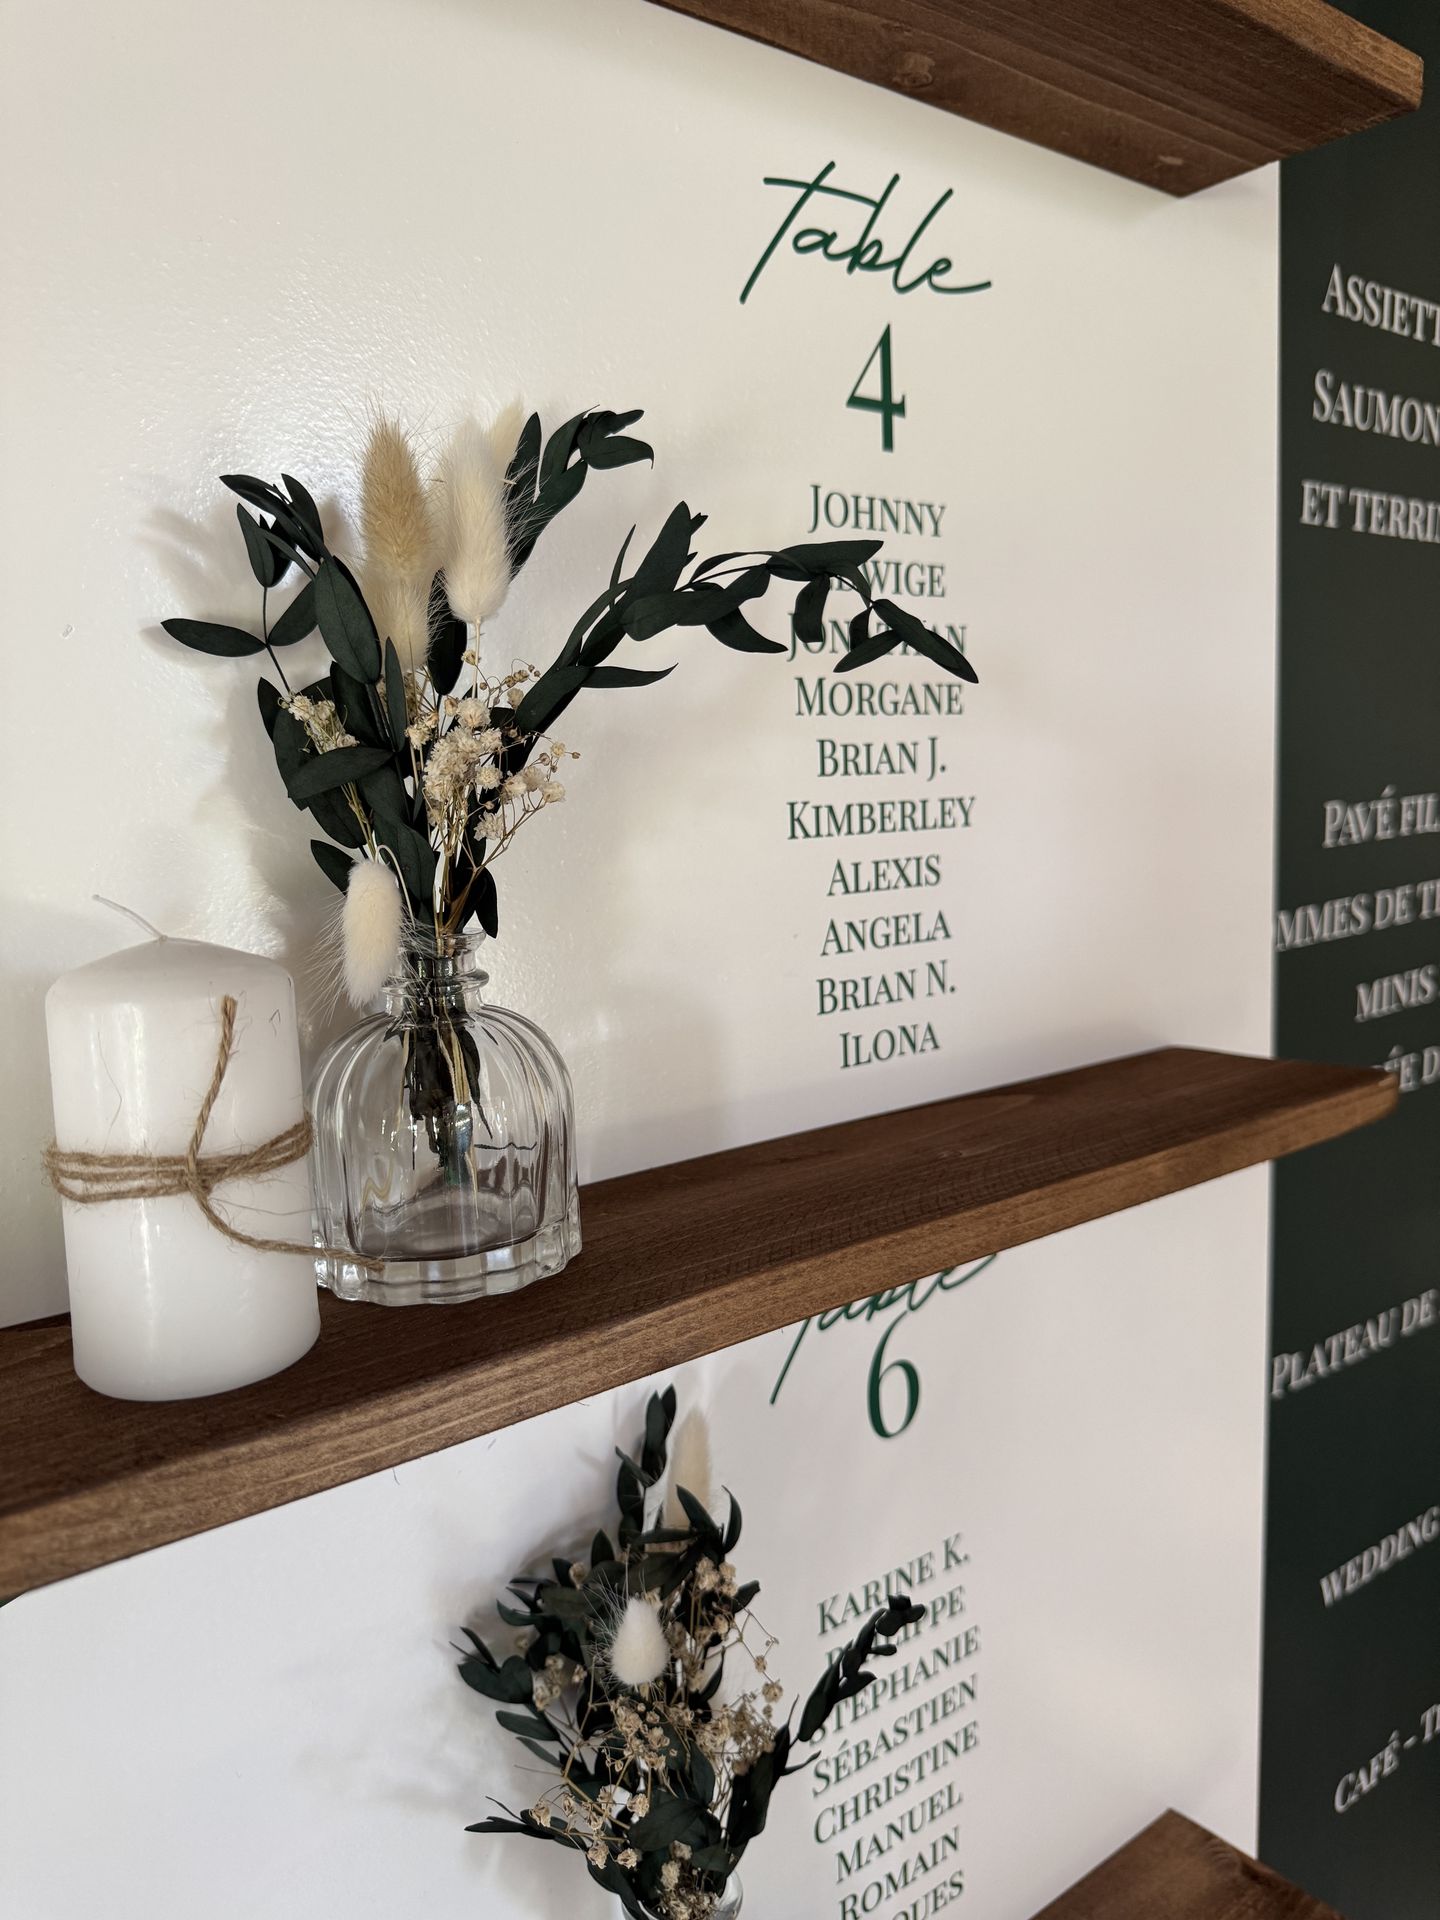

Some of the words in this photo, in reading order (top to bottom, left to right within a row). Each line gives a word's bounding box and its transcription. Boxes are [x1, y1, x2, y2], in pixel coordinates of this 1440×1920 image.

[846, 322, 906, 452] 4
[1312, 368, 1440, 447] SAUMON
[807, 484, 947, 538] JOHNNY
[1300, 480, 1346, 530] ET
[1349, 487, 1440, 544] TERRI
[794, 677, 964, 717] MORGANE
[816, 738, 919, 777] BRIAN
[927, 736, 946, 782] J.
[786, 796, 976, 840] KIMBERLEY
[1322, 784, 1398, 849] PAVÉ
[827, 854, 941, 896] ALEXIS
[1373, 884, 1416, 930] DE
[1416, 878, 1440, 919] T
[820, 909, 952, 956] ANGELA
[816, 969, 916, 1016] BRIAN
[925, 959, 956, 998] N.
[1354, 963, 1439, 1023] MINIS
[839, 1021, 941, 1069] ILONA
[867, 1310, 920, 1439] 6
[1271, 1306, 1400, 1398] PLATEAU
[1400, 1288, 1438, 1337] DE
[816, 1551, 935, 1636] KARINE
[942, 1532, 970, 1572] K.
[1319, 1505, 1440, 1608] WEDDING
[812, 1673, 978, 1798] SÉBASTIEN
[813, 1721, 979, 1845] CHRISTINE
[1334, 1729, 1400, 1814] CAFÉ
[836, 1781, 963, 1884] MANUEL
[838, 1825, 960, 1920] ROMAIN
[890, 1869, 964, 1920] UES
